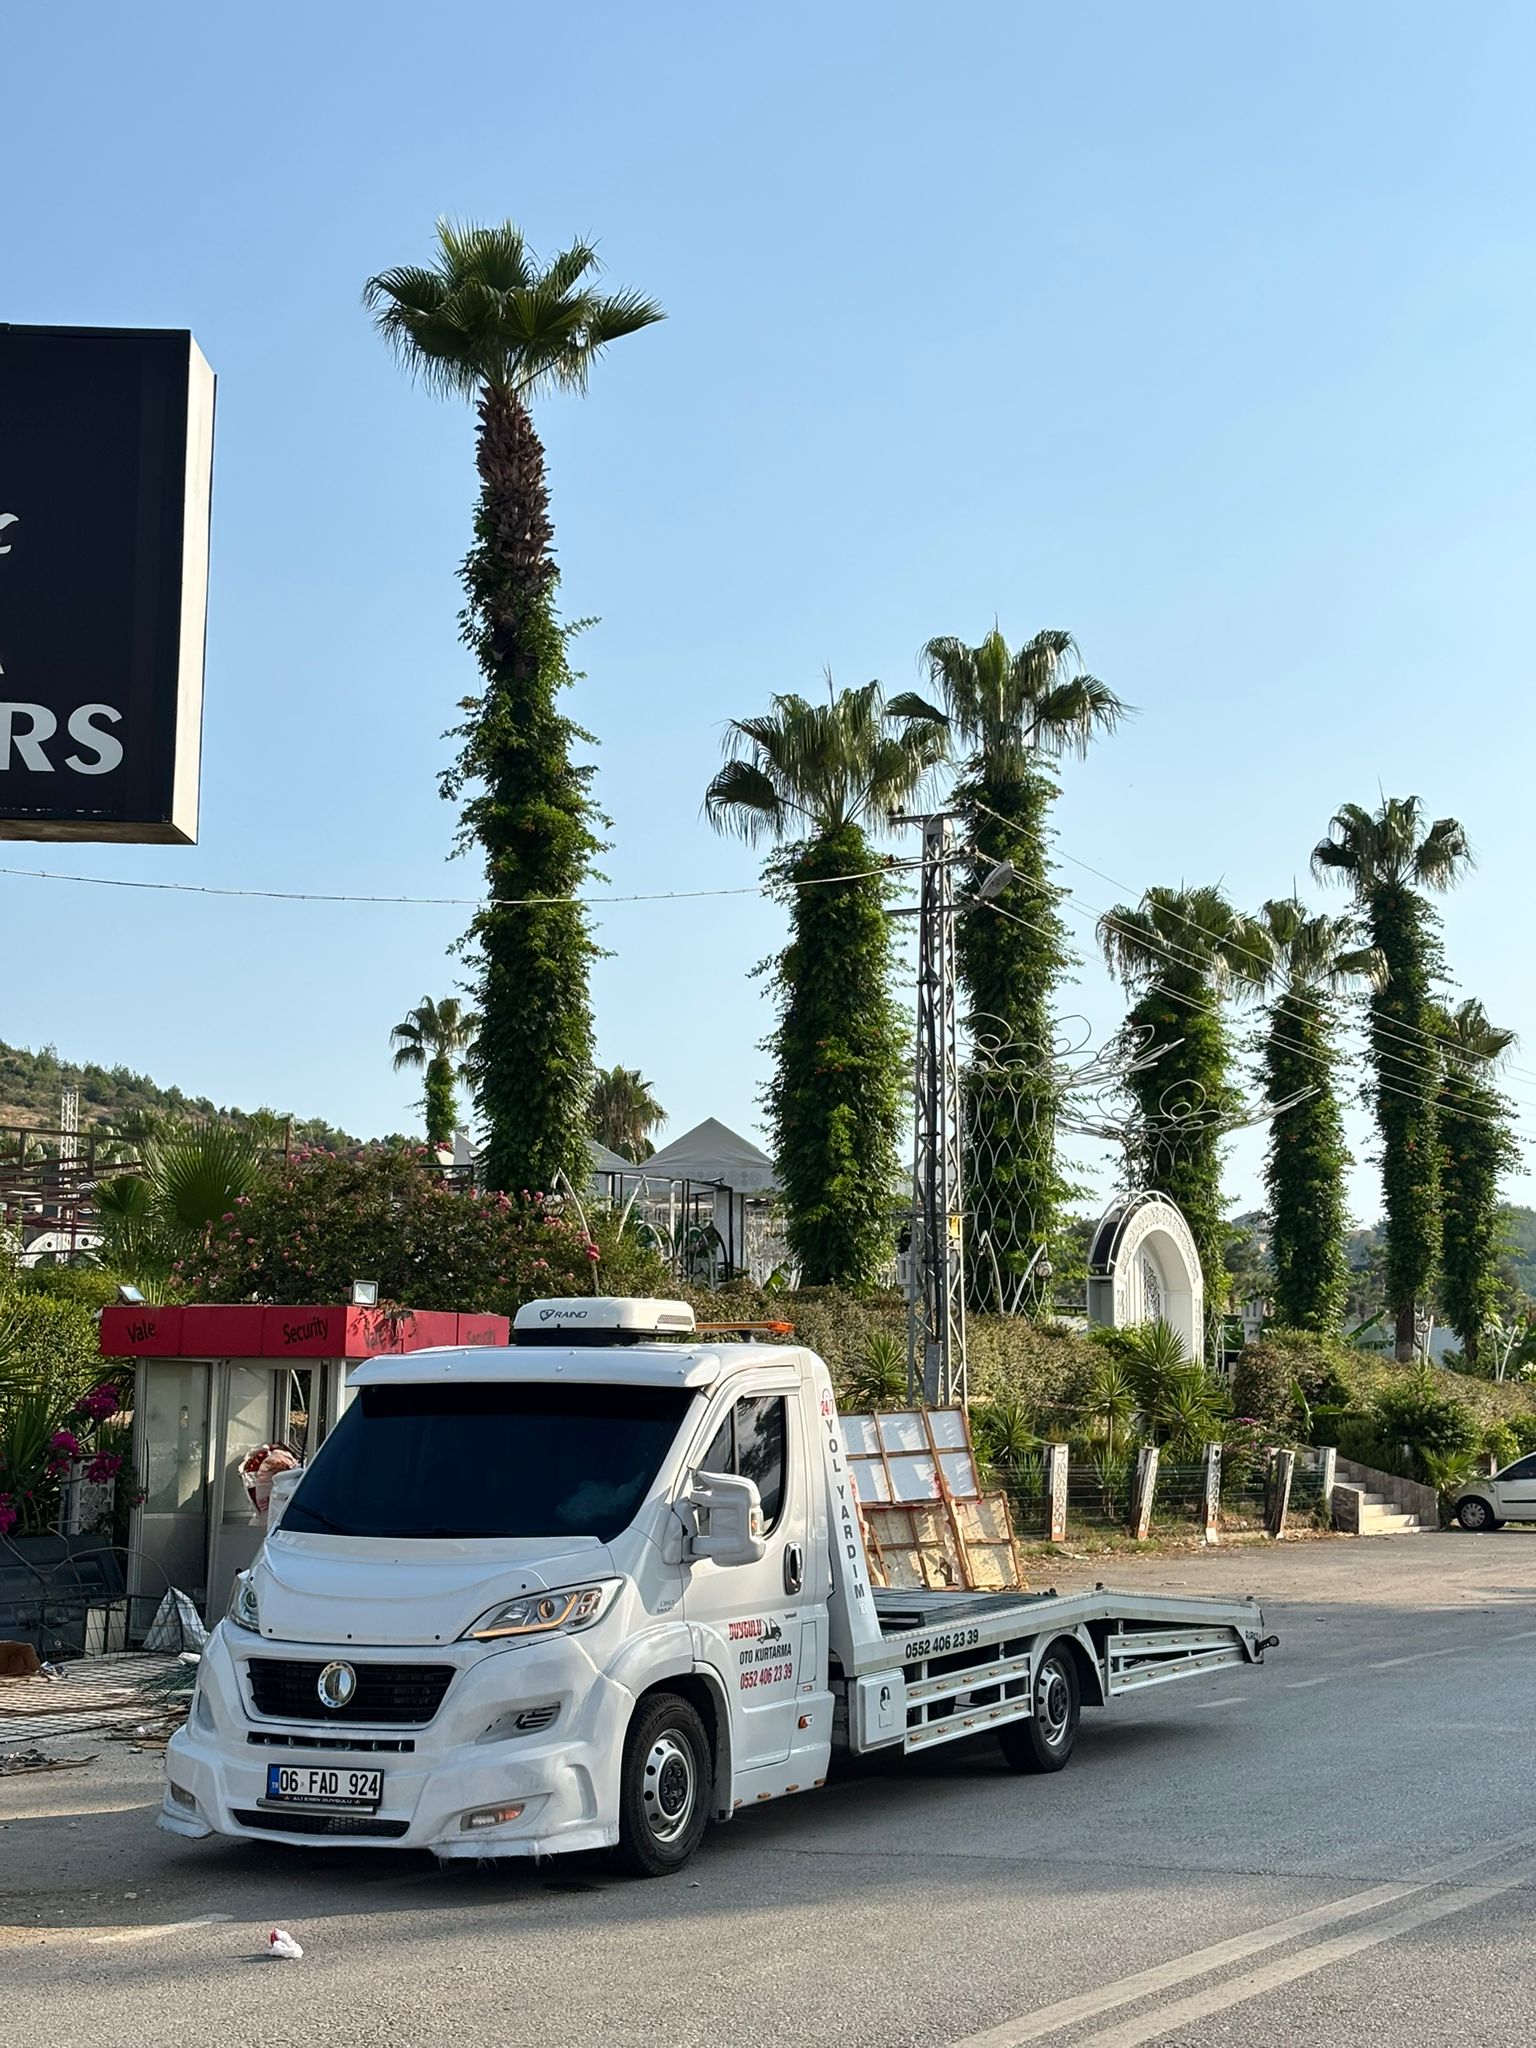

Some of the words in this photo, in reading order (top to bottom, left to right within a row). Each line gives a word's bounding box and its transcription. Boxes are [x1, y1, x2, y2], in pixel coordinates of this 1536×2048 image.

[127, 1320, 156, 1343] Vale
[283, 1317, 328, 1345] Security
[825, 1419, 841, 1473] YOL
[837, 1485, 865, 1599] YARDIM
[728, 1619, 762, 1641] DUYGULU
[740, 1650, 753, 1665] OTO
[755, 1643, 792, 1662] KURTARMA
[905, 1639, 930, 1659] 0552
[932, 1634, 951, 1653] 406
[953, 1632, 965, 1648] 23
[968, 1629, 979, 1643] 39
[740, 1670, 758, 1690] 0552
[759, 1667, 773, 1685] 406
[774, 1665, 782, 1682] 23
[784, 1662, 793, 1680] 39
[280, 1770, 299, 1792] 06
[309, 1771, 338, 1794] FAD
[349, 1773, 378, 1796] 924
